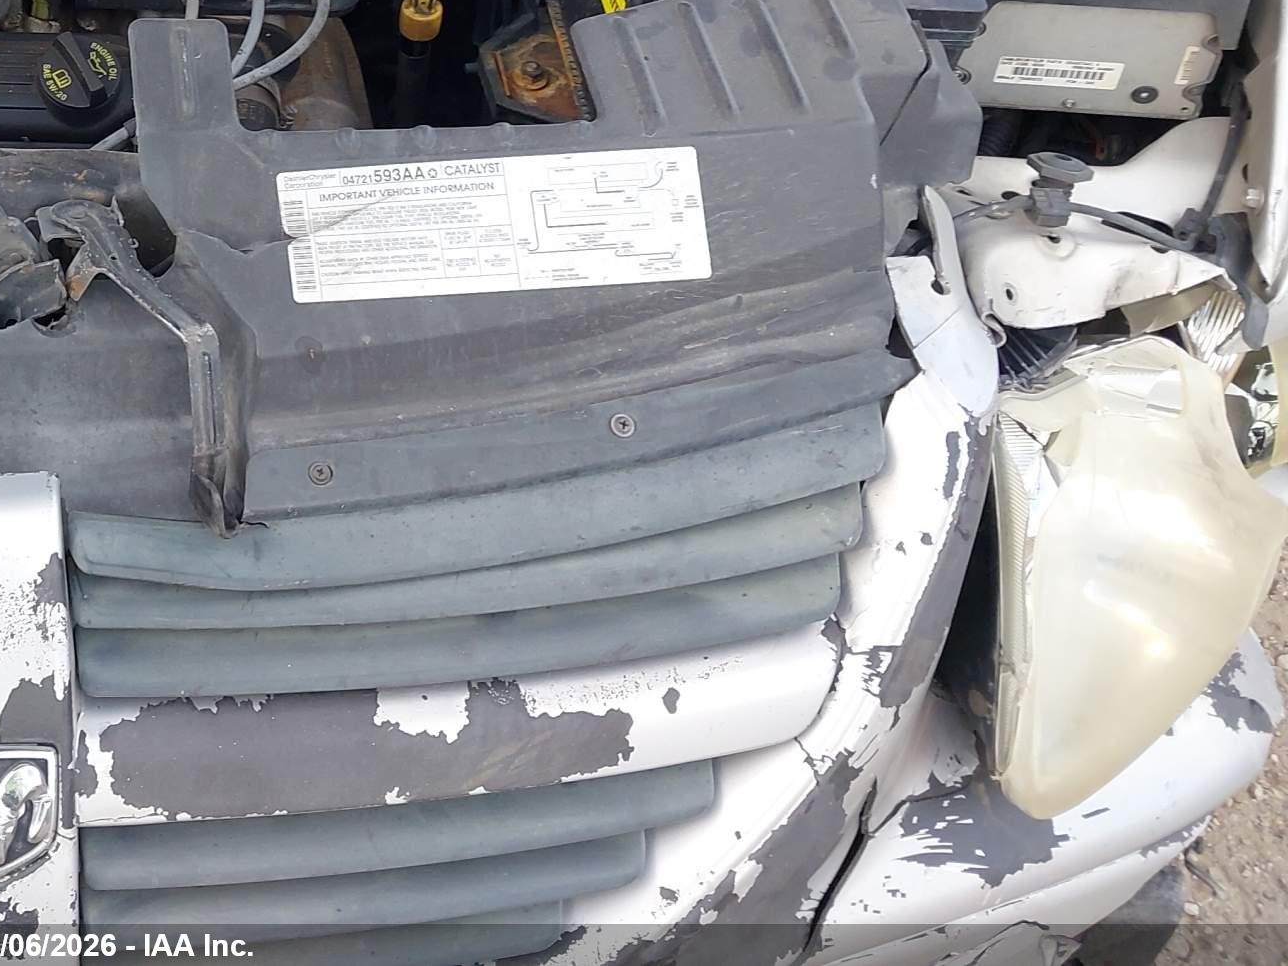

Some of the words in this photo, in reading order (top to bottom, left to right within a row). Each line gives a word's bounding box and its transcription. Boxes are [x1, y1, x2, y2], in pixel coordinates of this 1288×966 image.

[90, 42, 116, 67] ENGINE
[109, 67, 118, 81] OIL
[444, 162, 501, 177] CATALYST
[319, 189, 378, 203] IMPORTANT
[379, 186, 421, 198] VEHICLE
[424, 182, 495, 195] INFORMATION
